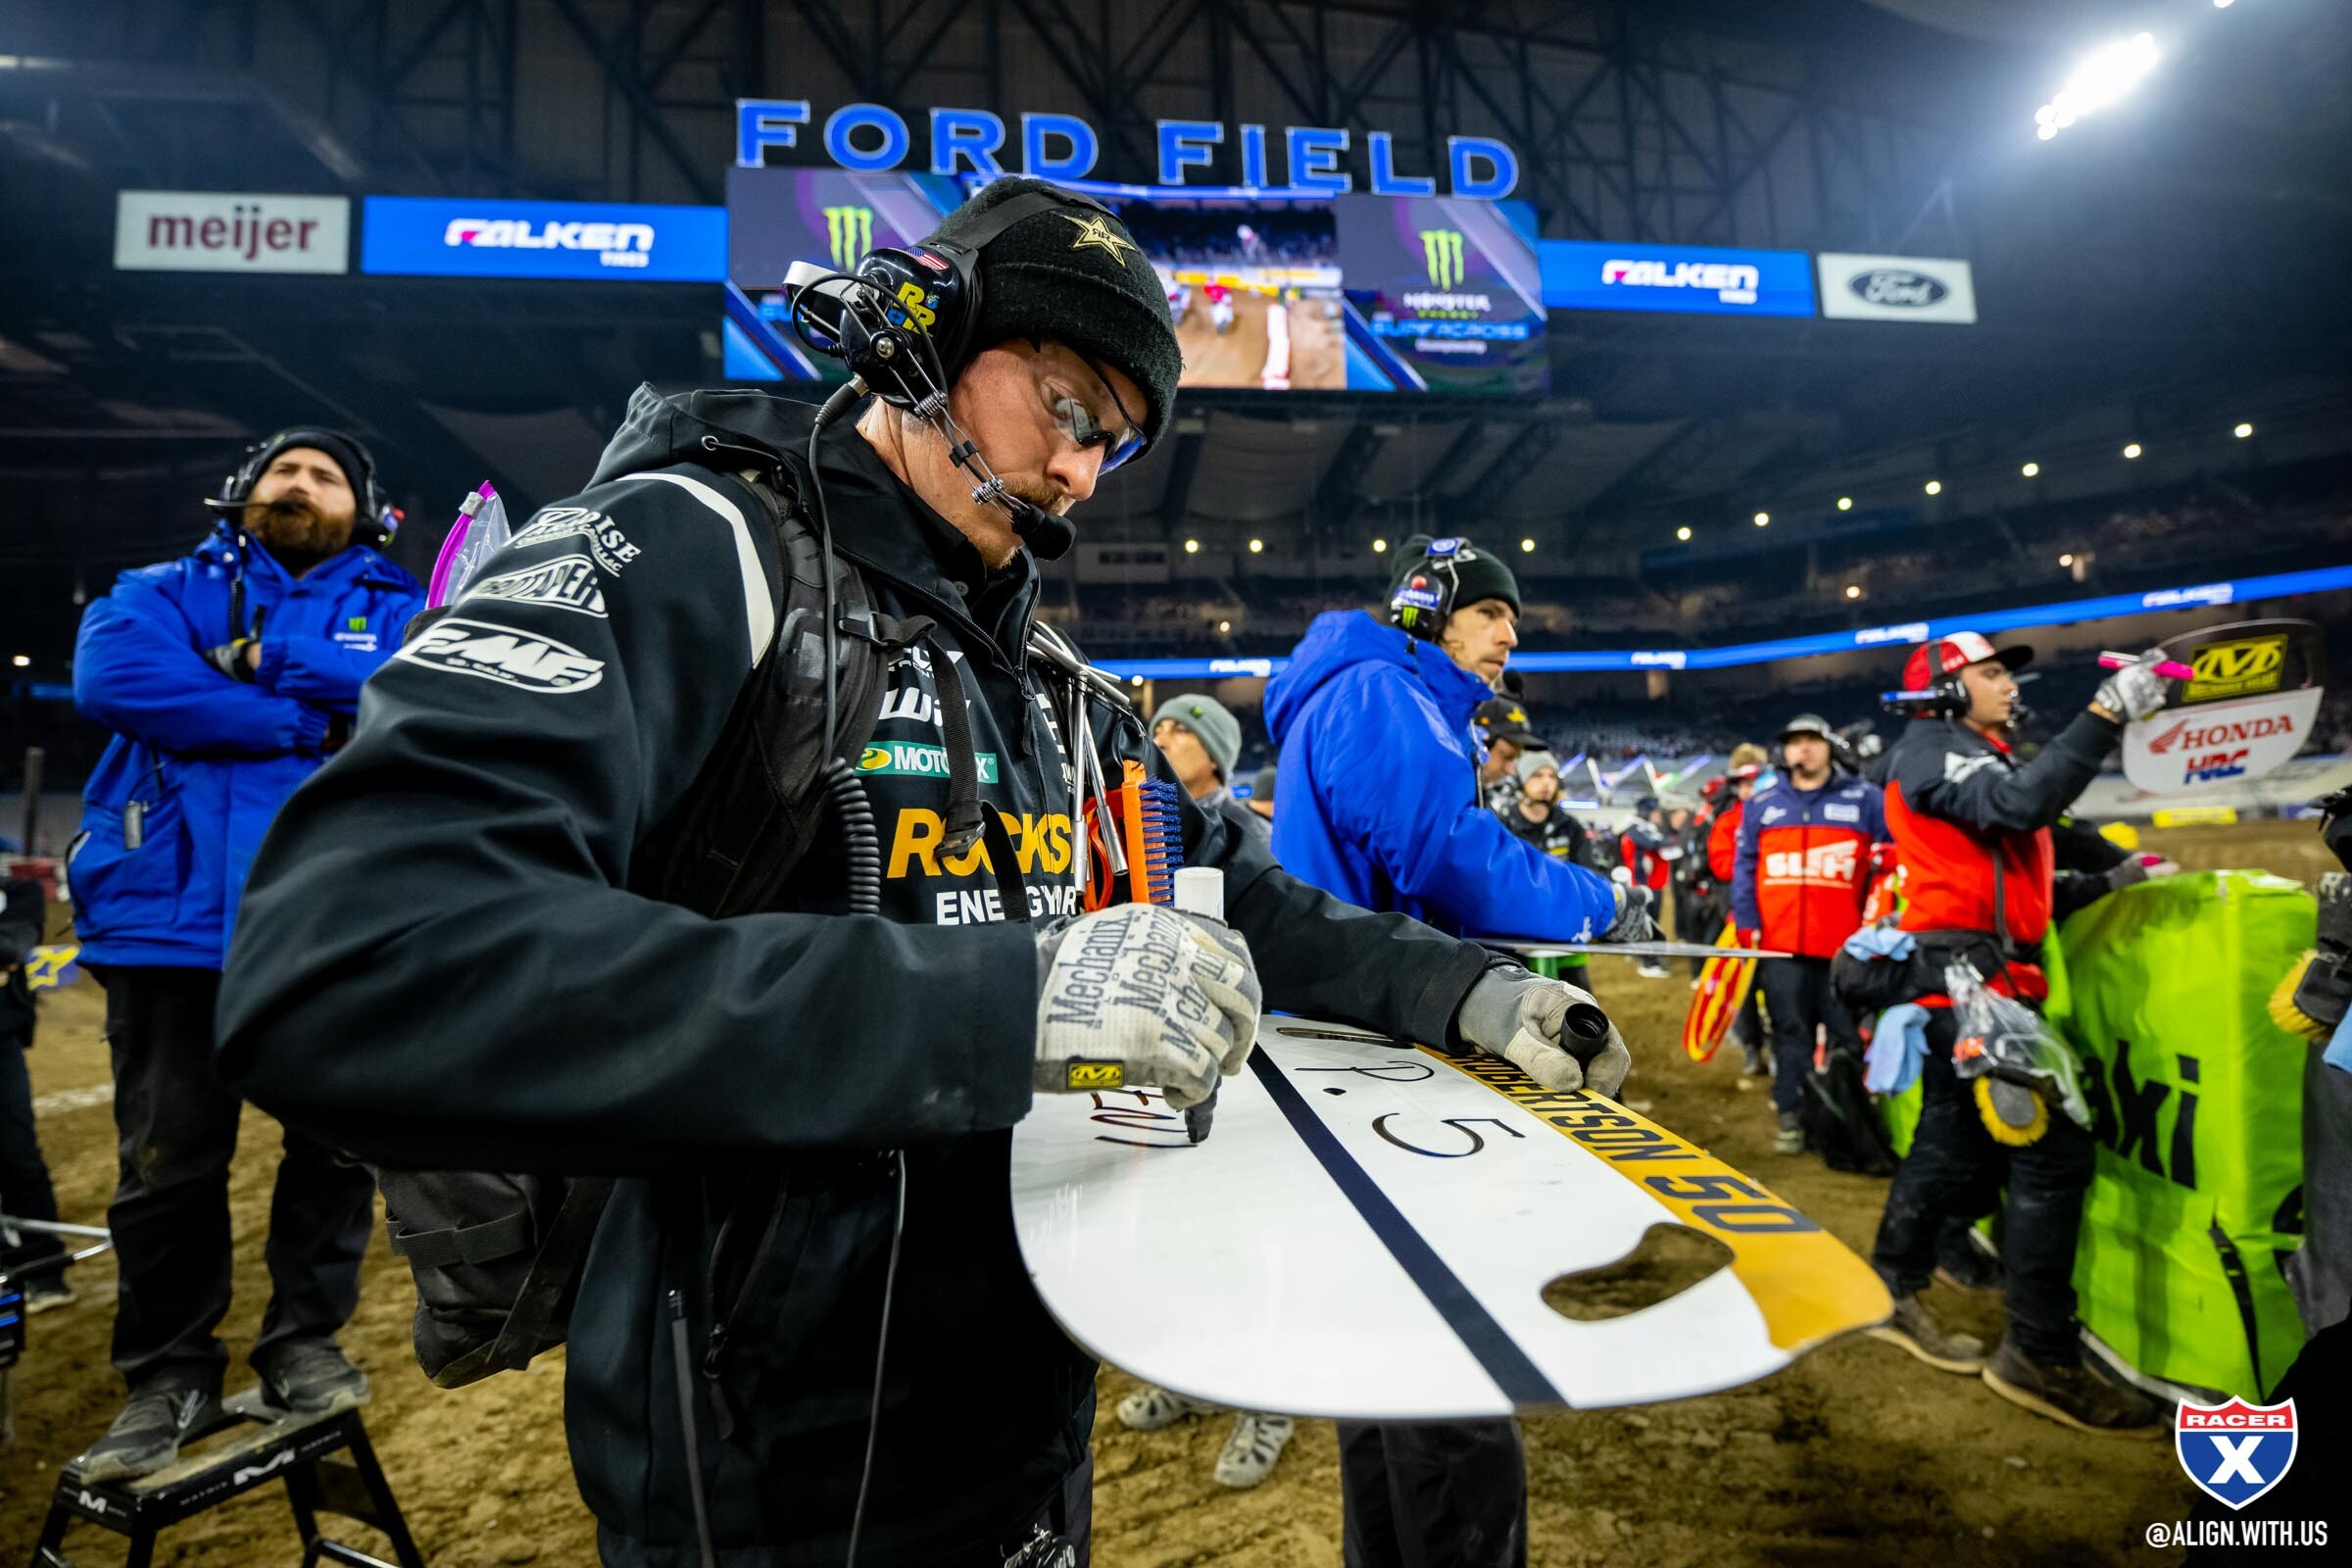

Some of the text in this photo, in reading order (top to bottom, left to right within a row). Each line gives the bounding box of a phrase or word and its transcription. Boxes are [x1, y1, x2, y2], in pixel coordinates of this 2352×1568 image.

[735, 98, 1519, 200] FORD FIELD
[148, 206, 317, 260] meijer
[444, 218, 655, 252] FALKEN
[417, 628, 606, 681] FMF
[2180, 714, 2294, 751] HONDA
[1643, 1176, 1822, 1233] 50
